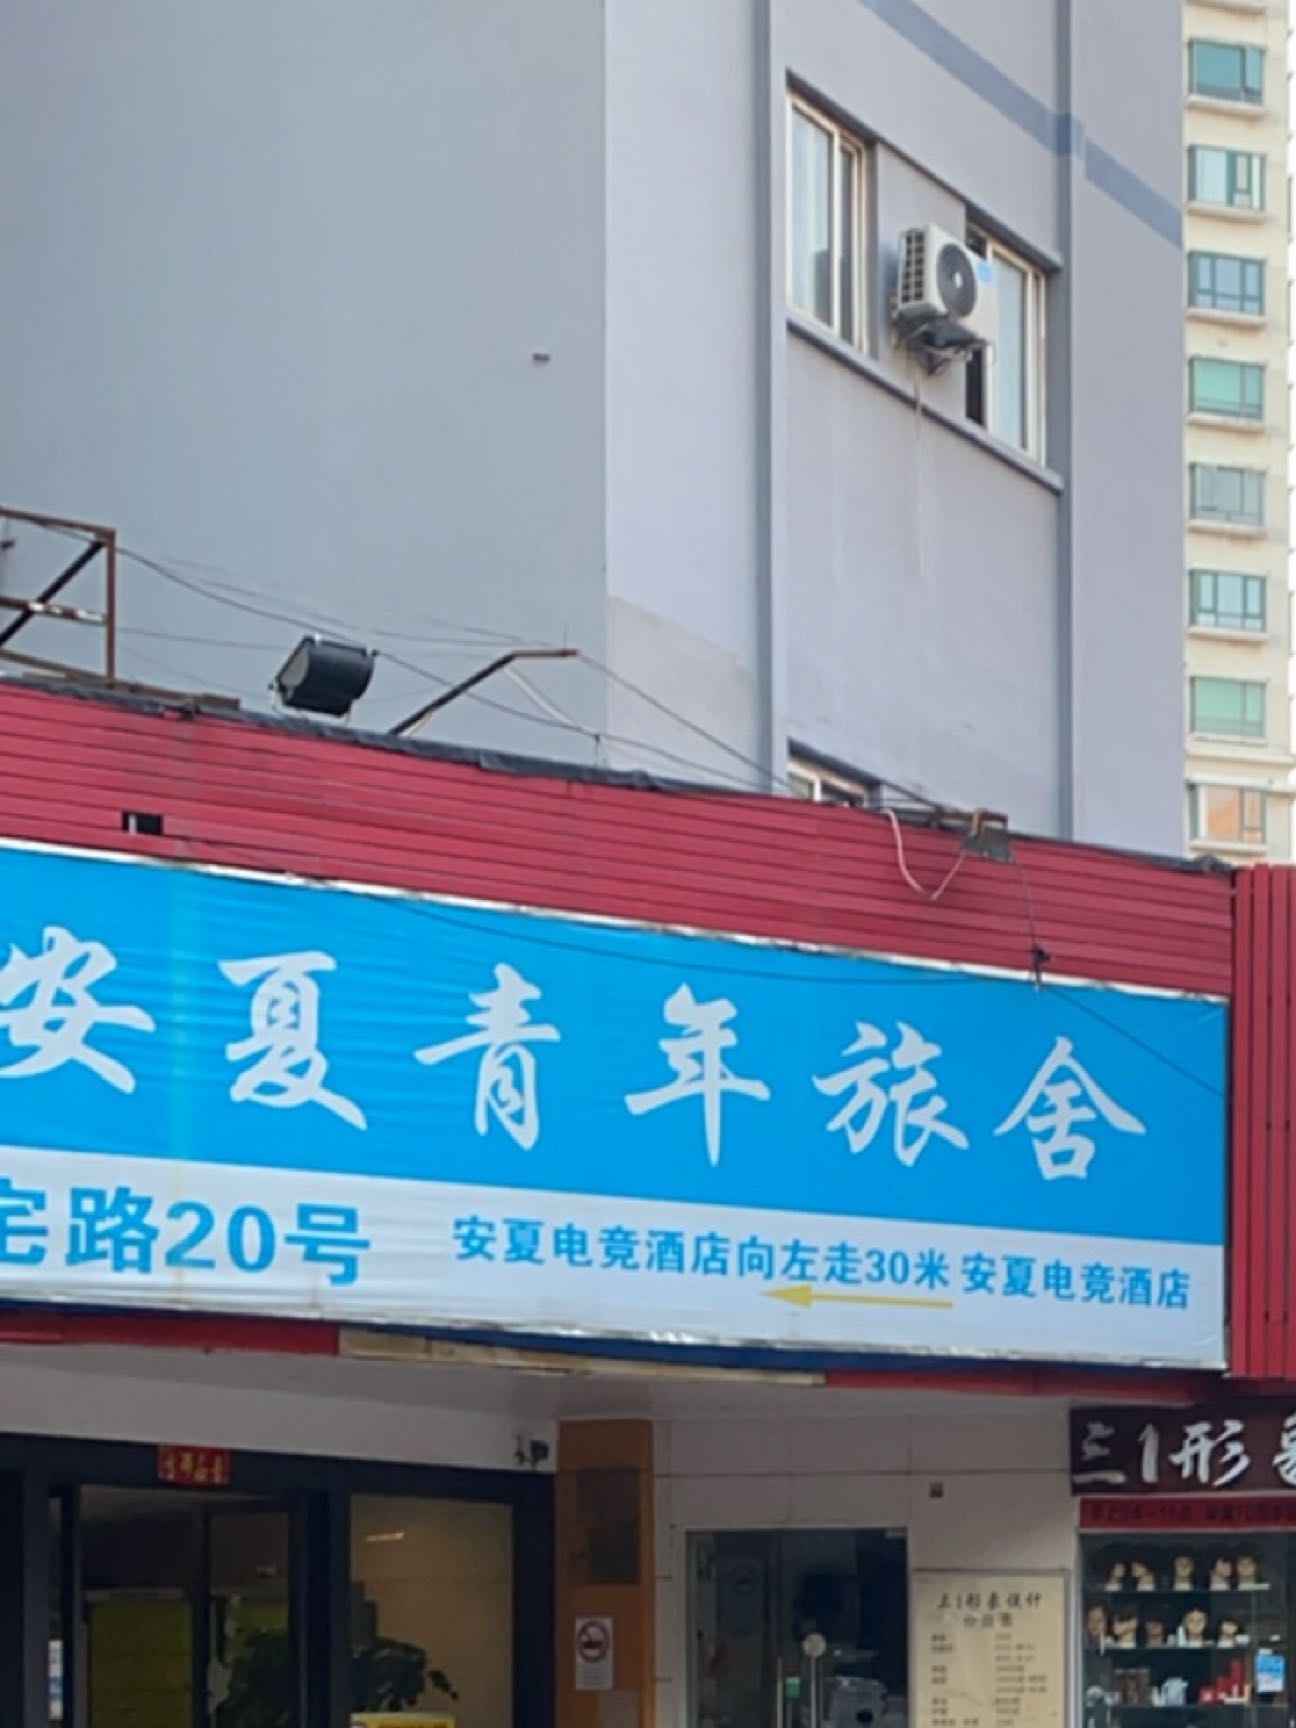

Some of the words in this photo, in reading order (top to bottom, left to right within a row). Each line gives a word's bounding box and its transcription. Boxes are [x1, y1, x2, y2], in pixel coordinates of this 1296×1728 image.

[0, 926, 1146, 1181] 安夏青年旅舍
[453, 1214, 950, 1290] 安夏电竞酒店向左走30米
[962, 1252, 1191, 1310] 安夏电竞酒店
